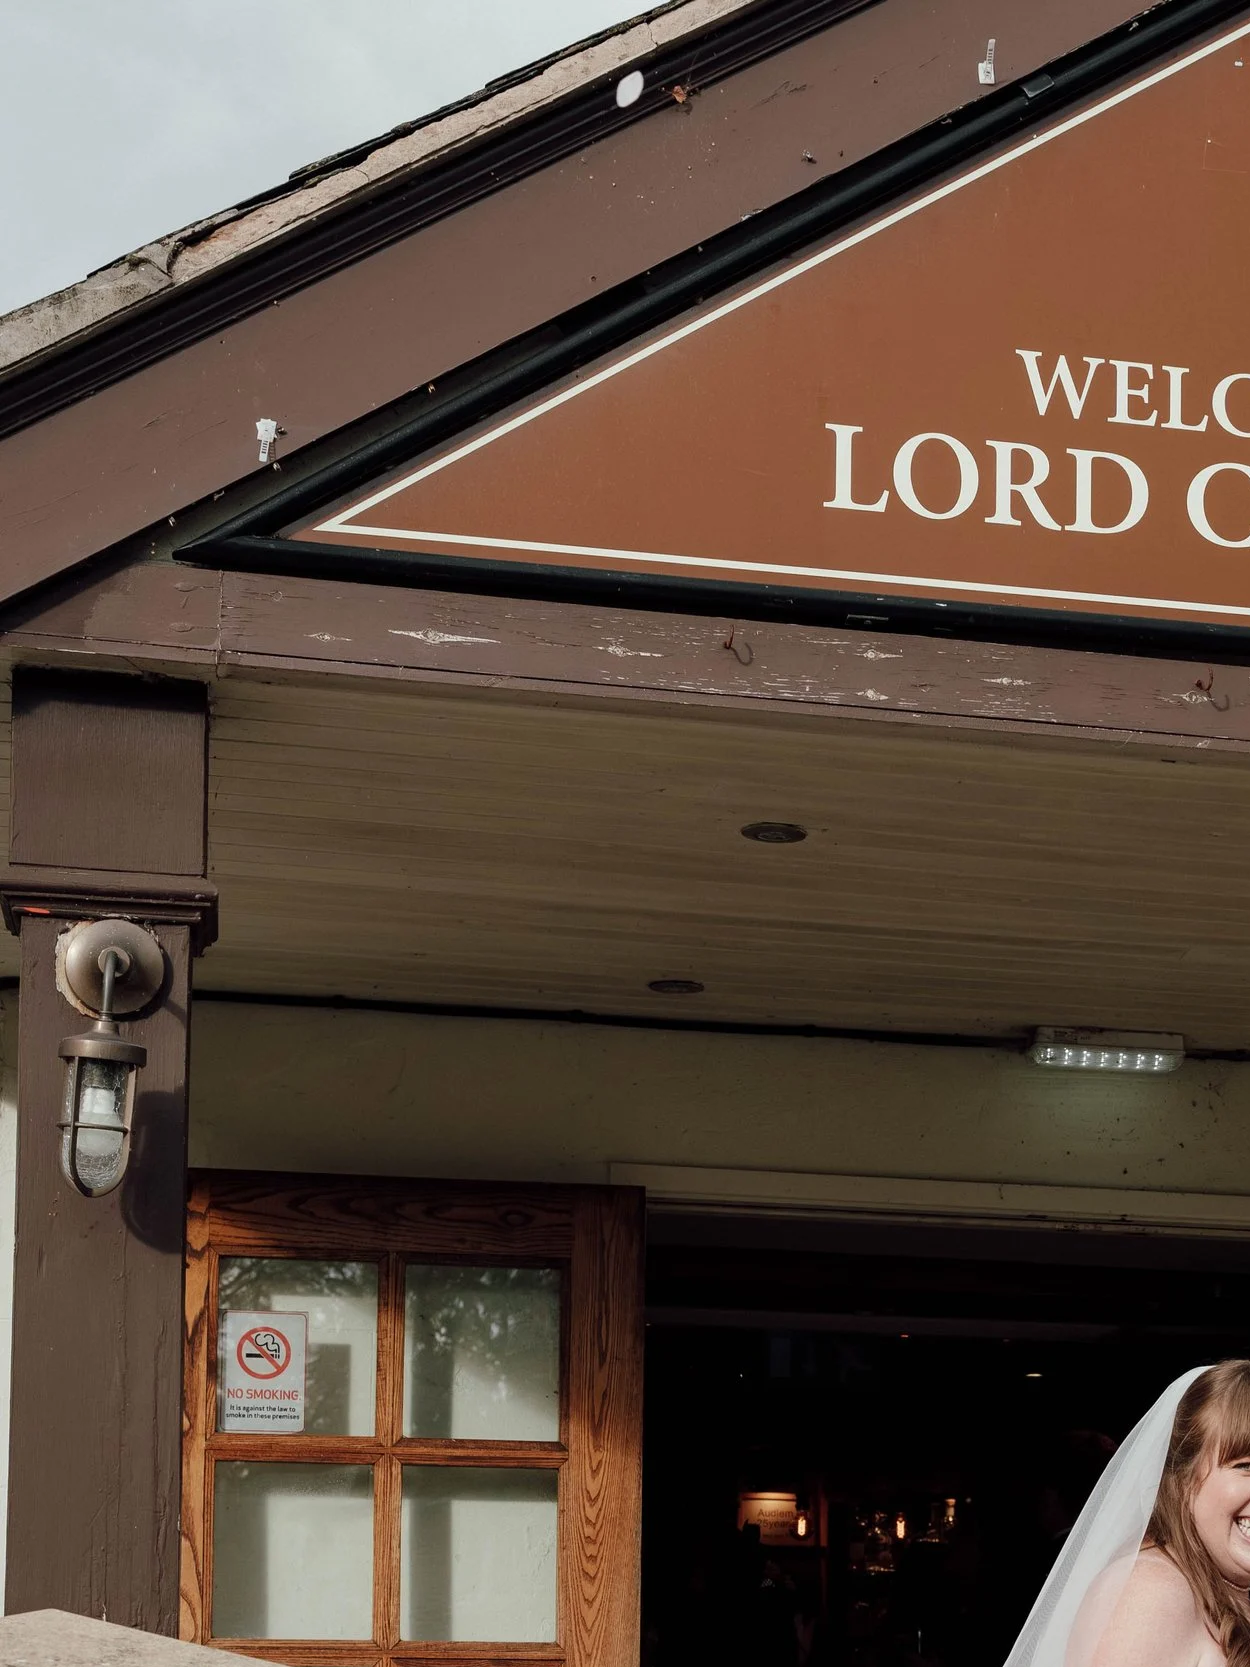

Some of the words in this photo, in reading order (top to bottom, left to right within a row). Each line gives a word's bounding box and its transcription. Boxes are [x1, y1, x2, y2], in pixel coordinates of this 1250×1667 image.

[823, 423, 1149, 534] LORD
[227, 1388, 243, 1399] NO
[243, 1405, 265, 1413] against
